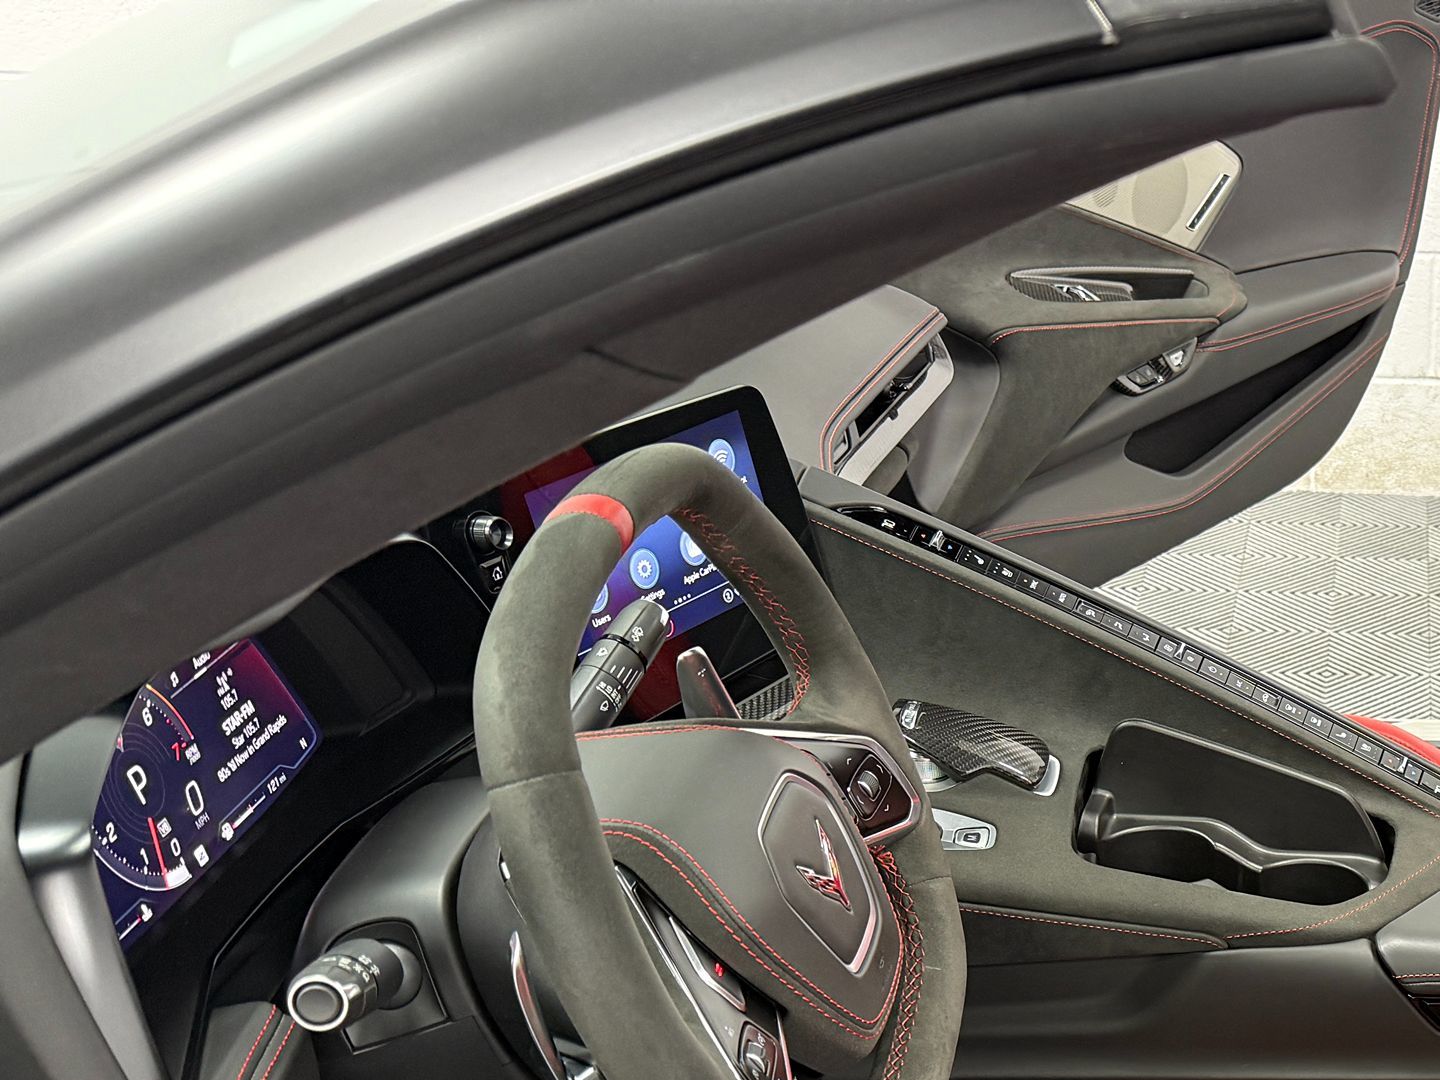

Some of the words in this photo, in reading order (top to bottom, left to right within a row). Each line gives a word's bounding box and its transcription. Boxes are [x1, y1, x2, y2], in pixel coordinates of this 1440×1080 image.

[684, 572, 699, 585] Apple
[592, 614, 611, 628] Users
[221, 689, 238, 710] 105.7
[142, 707, 153, 726] 6
[232, 733, 245, 749] Star
[243, 717, 260, 738] 105.7
[171, 742, 180, 761] 7
[185, 743, 198, 760] RPM
[217, 767, 231, 782] 80s
[234, 750, 250, 767] Now
[247, 745, 255, 755] in
[252, 728, 270, 750] Grand
[268, 714, 287, 736] Rapids
[299, 737, 307, 750] N
[126, 765, 147, 805] P
[267, 776, 279, 794] 121
[185, 780, 204, 816] 0
[195, 812, 210, 830] MPH
[106, 822, 117, 843] 2
[140, 847, 149, 865] 1
[170, 837, 181, 857] 0
